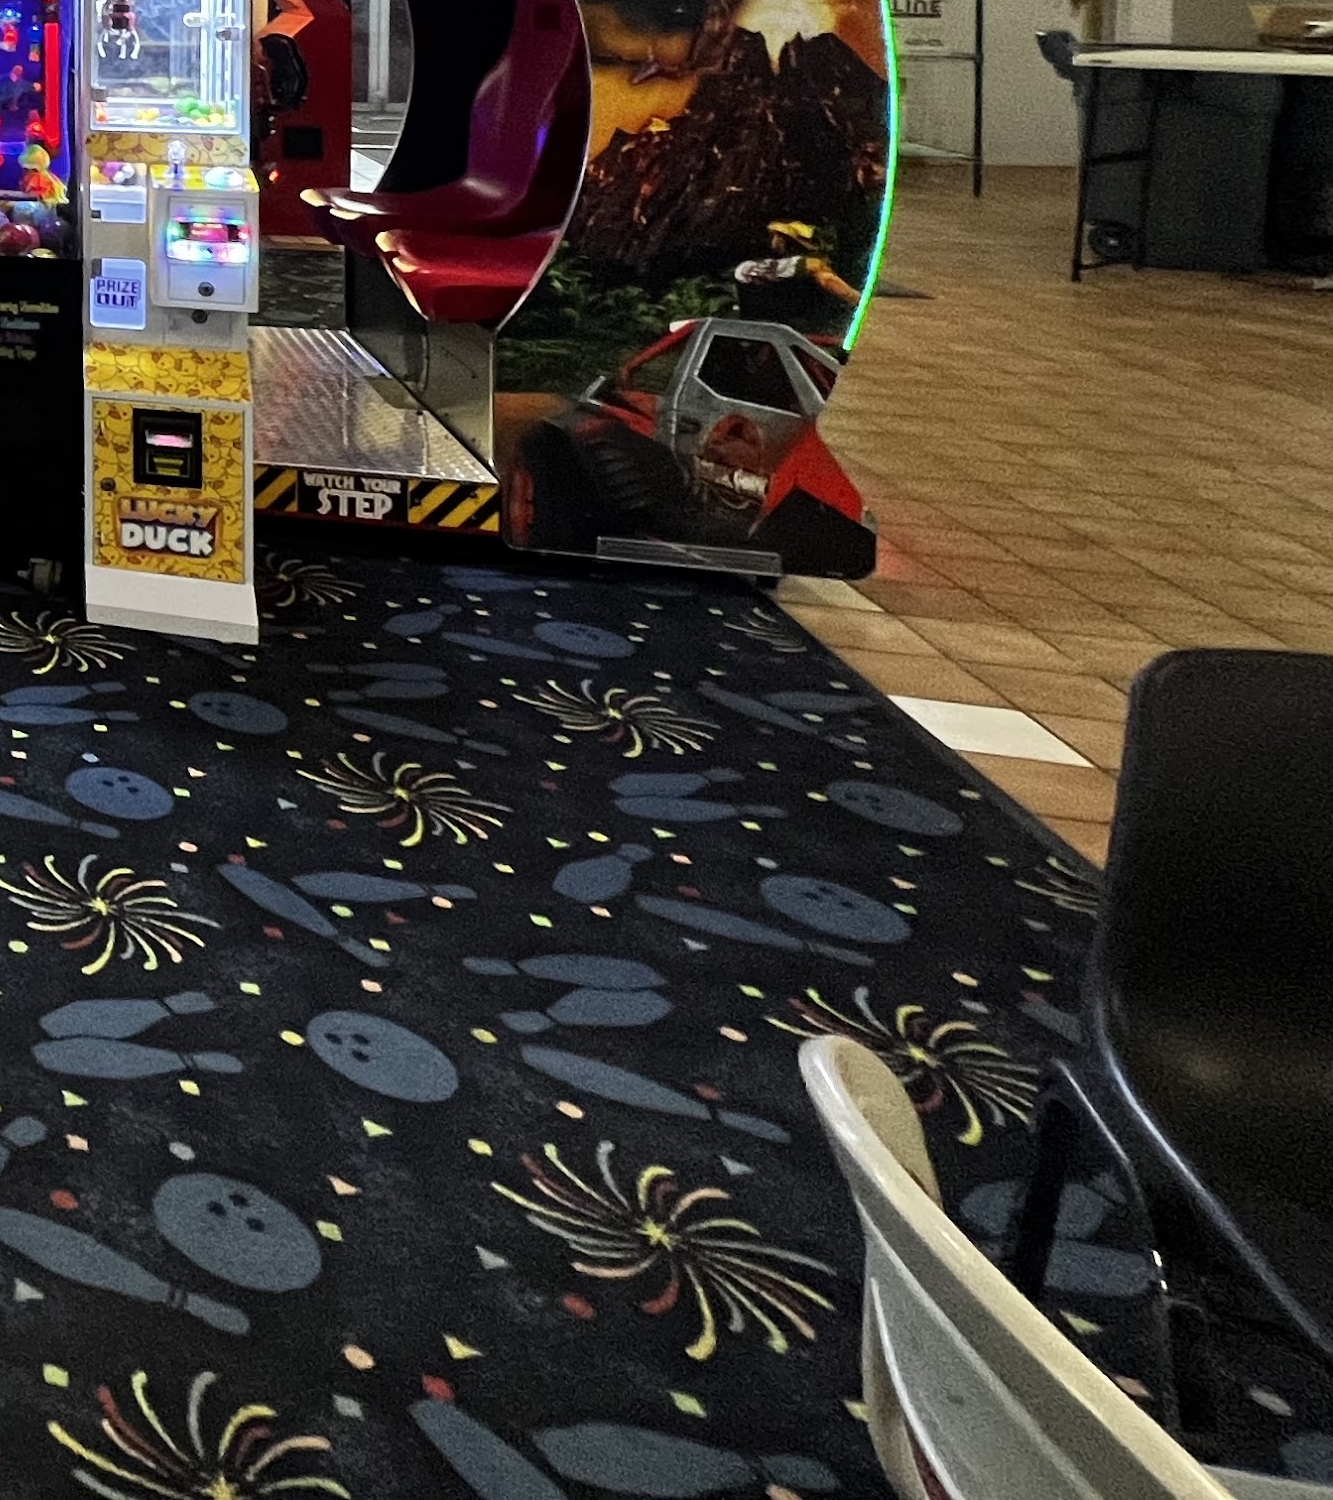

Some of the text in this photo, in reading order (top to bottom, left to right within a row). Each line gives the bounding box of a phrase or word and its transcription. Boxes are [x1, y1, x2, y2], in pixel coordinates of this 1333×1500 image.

[96, 279, 141, 293] PRIZE
[96, 293, 138, 308] OUT
[303, 471, 401, 494] WATCH YOUR
[119, 497, 220, 527] LUCKY
[316, 487, 392, 520] STEP
[120, 522, 214, 557] DUCK
